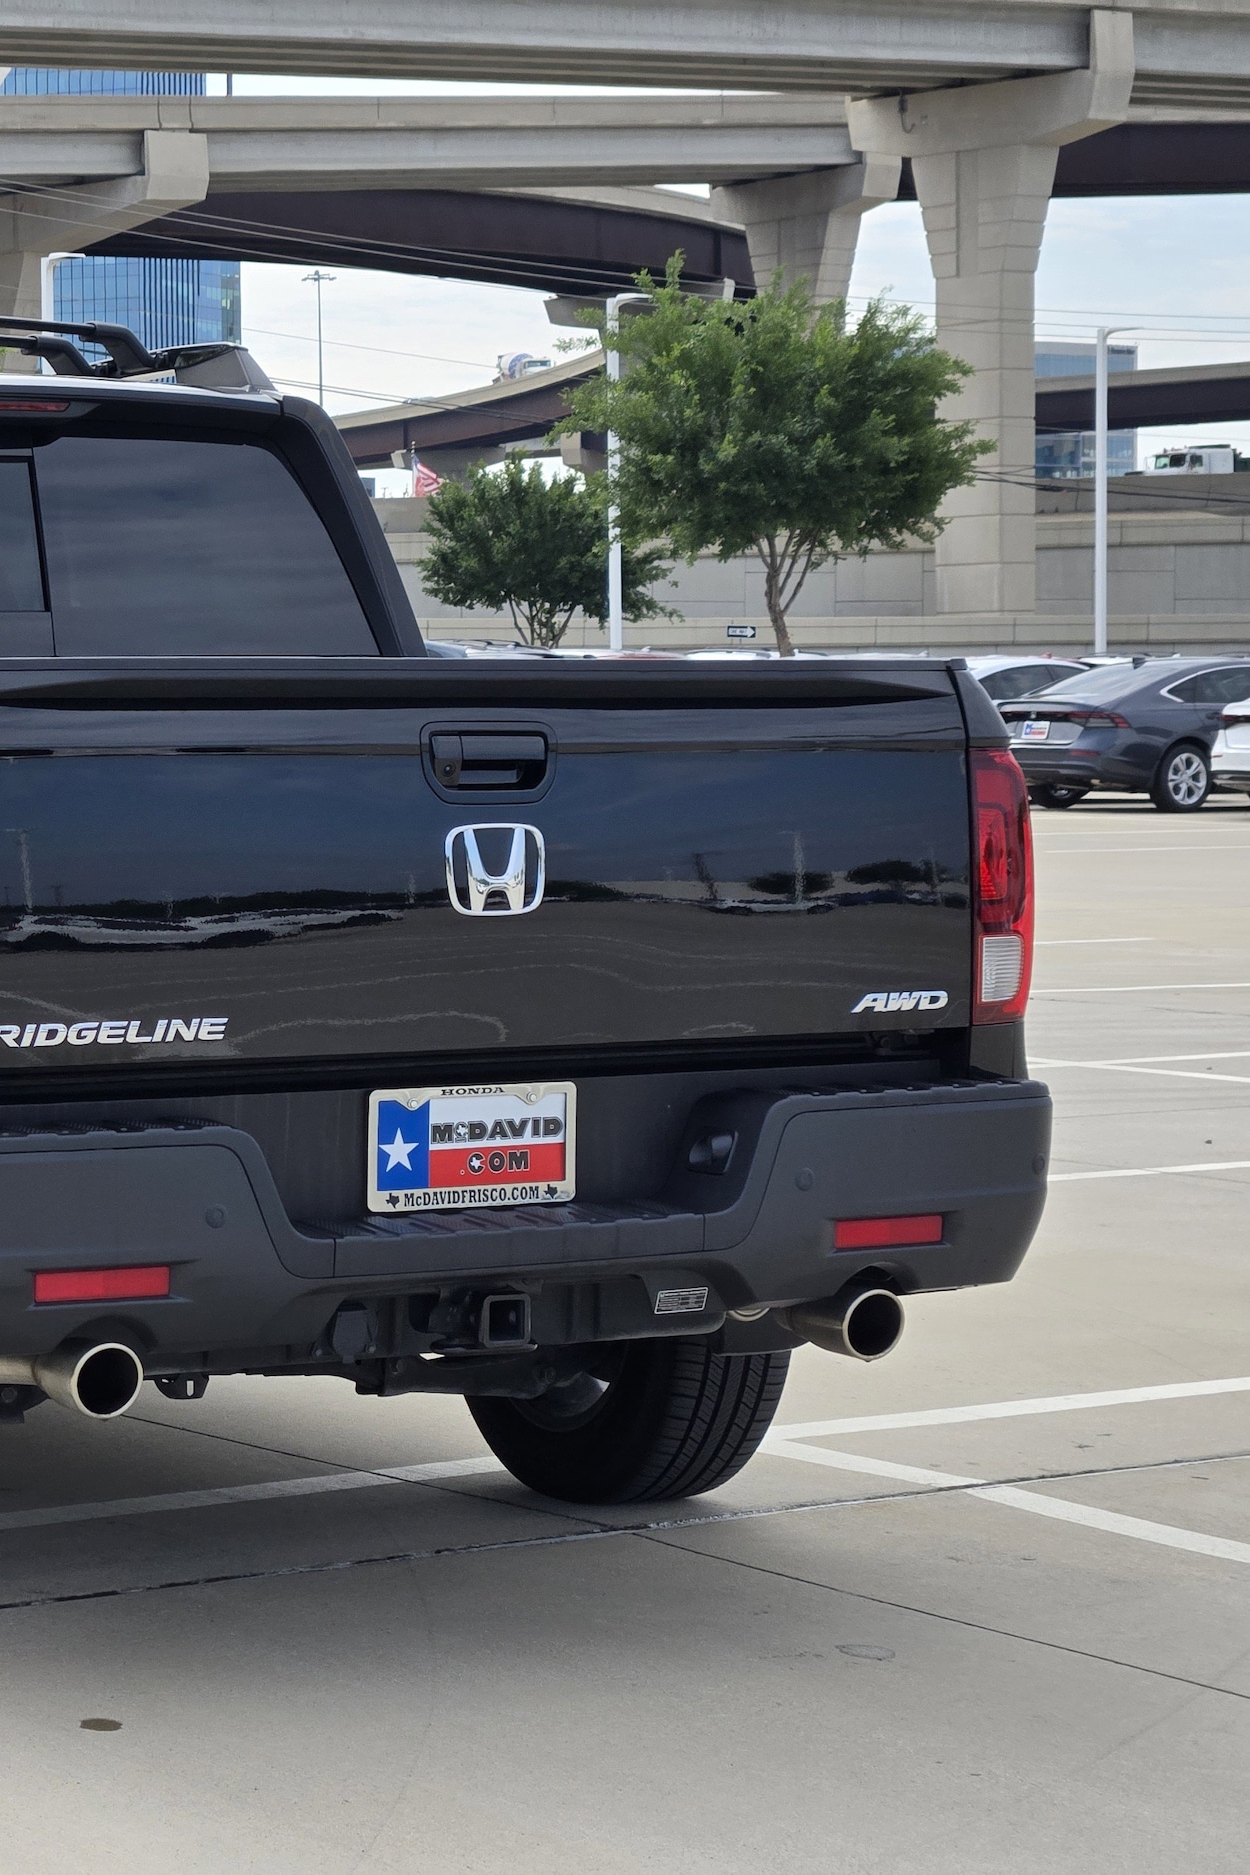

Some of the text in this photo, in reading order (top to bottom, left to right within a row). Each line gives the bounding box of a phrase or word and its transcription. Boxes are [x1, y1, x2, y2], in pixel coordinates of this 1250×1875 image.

[850, 990, 949, 1014] AWD
[440, 1086, 506, 1097] HONDA
[403, 1185, 540, 1208] McDAVIDFRISCO.COM
